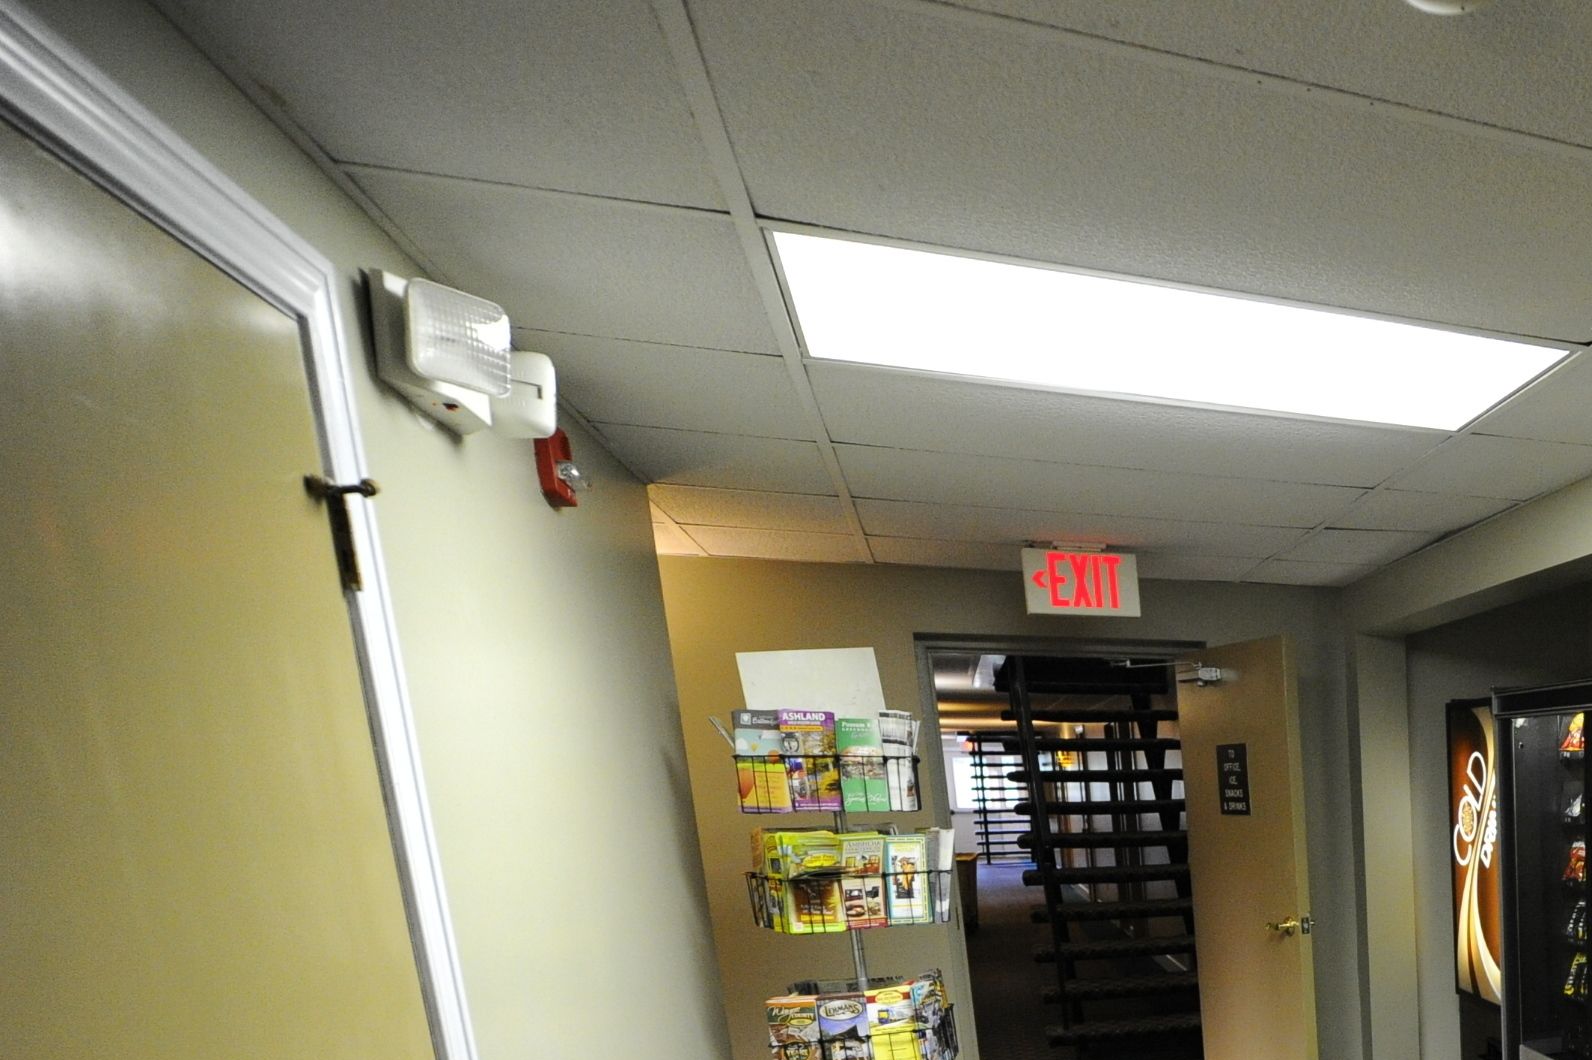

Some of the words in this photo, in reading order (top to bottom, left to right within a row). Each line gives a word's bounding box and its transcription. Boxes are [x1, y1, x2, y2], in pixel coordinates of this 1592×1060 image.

[1046, 552, 1122, 609] EXIT
[781, 712, 826, 722] ASHLAND
[1227, 749, 1235, 759] TO
[1225, 789, 1243, 798] SNACKS
[1229, 801, 1247, 811] DRINKS
[1453, 751, 1487, 866] COLD
